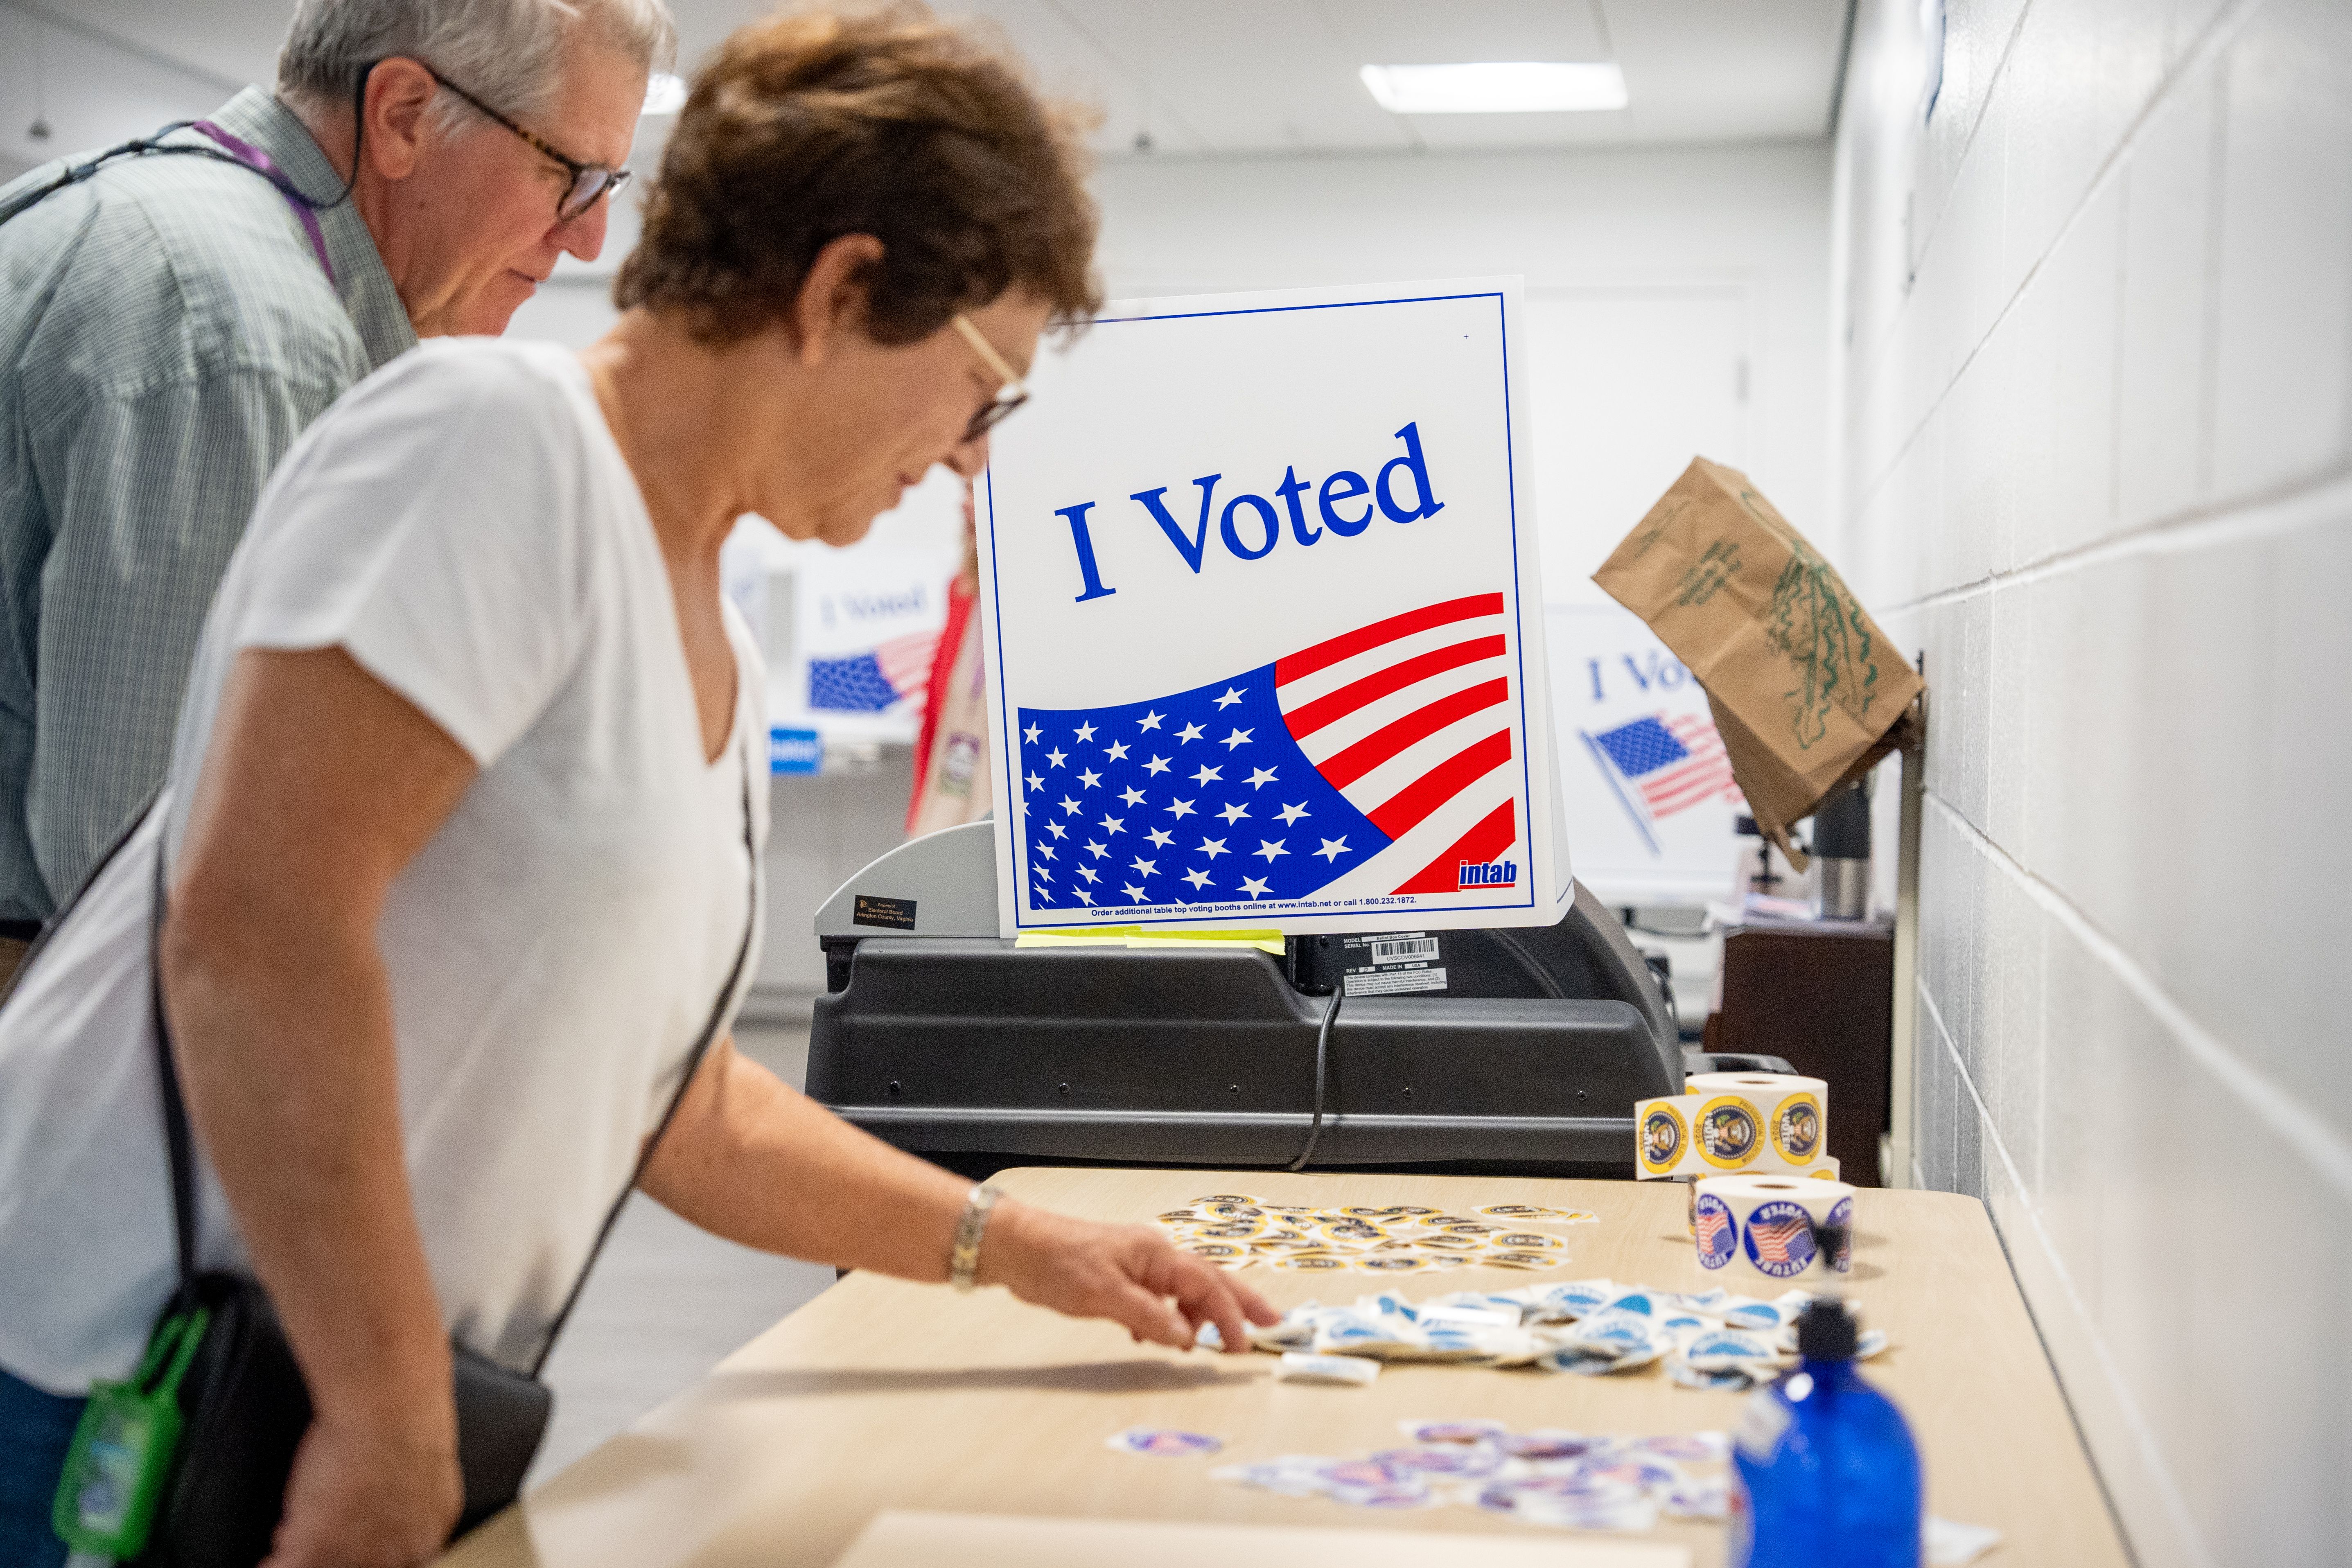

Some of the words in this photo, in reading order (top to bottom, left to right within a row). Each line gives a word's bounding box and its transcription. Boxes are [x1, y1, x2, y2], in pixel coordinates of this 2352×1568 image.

[1054, 501, 1117, 602] I
[1129, 421, 1445, 574] Voted
[1587, 657, 1605, 702] I
[1621, 650, 1697, 692] Vo
[1460, 860, 1517, 884] intab
[1359, 897, 1417, 905] 1.800.232.1872.
[1704, 1119, 1715, 1155] VOTED
[1760, 1204, 1803, 1220] VOTER
[1755, 1257, 1807, 1275] FUTURE
